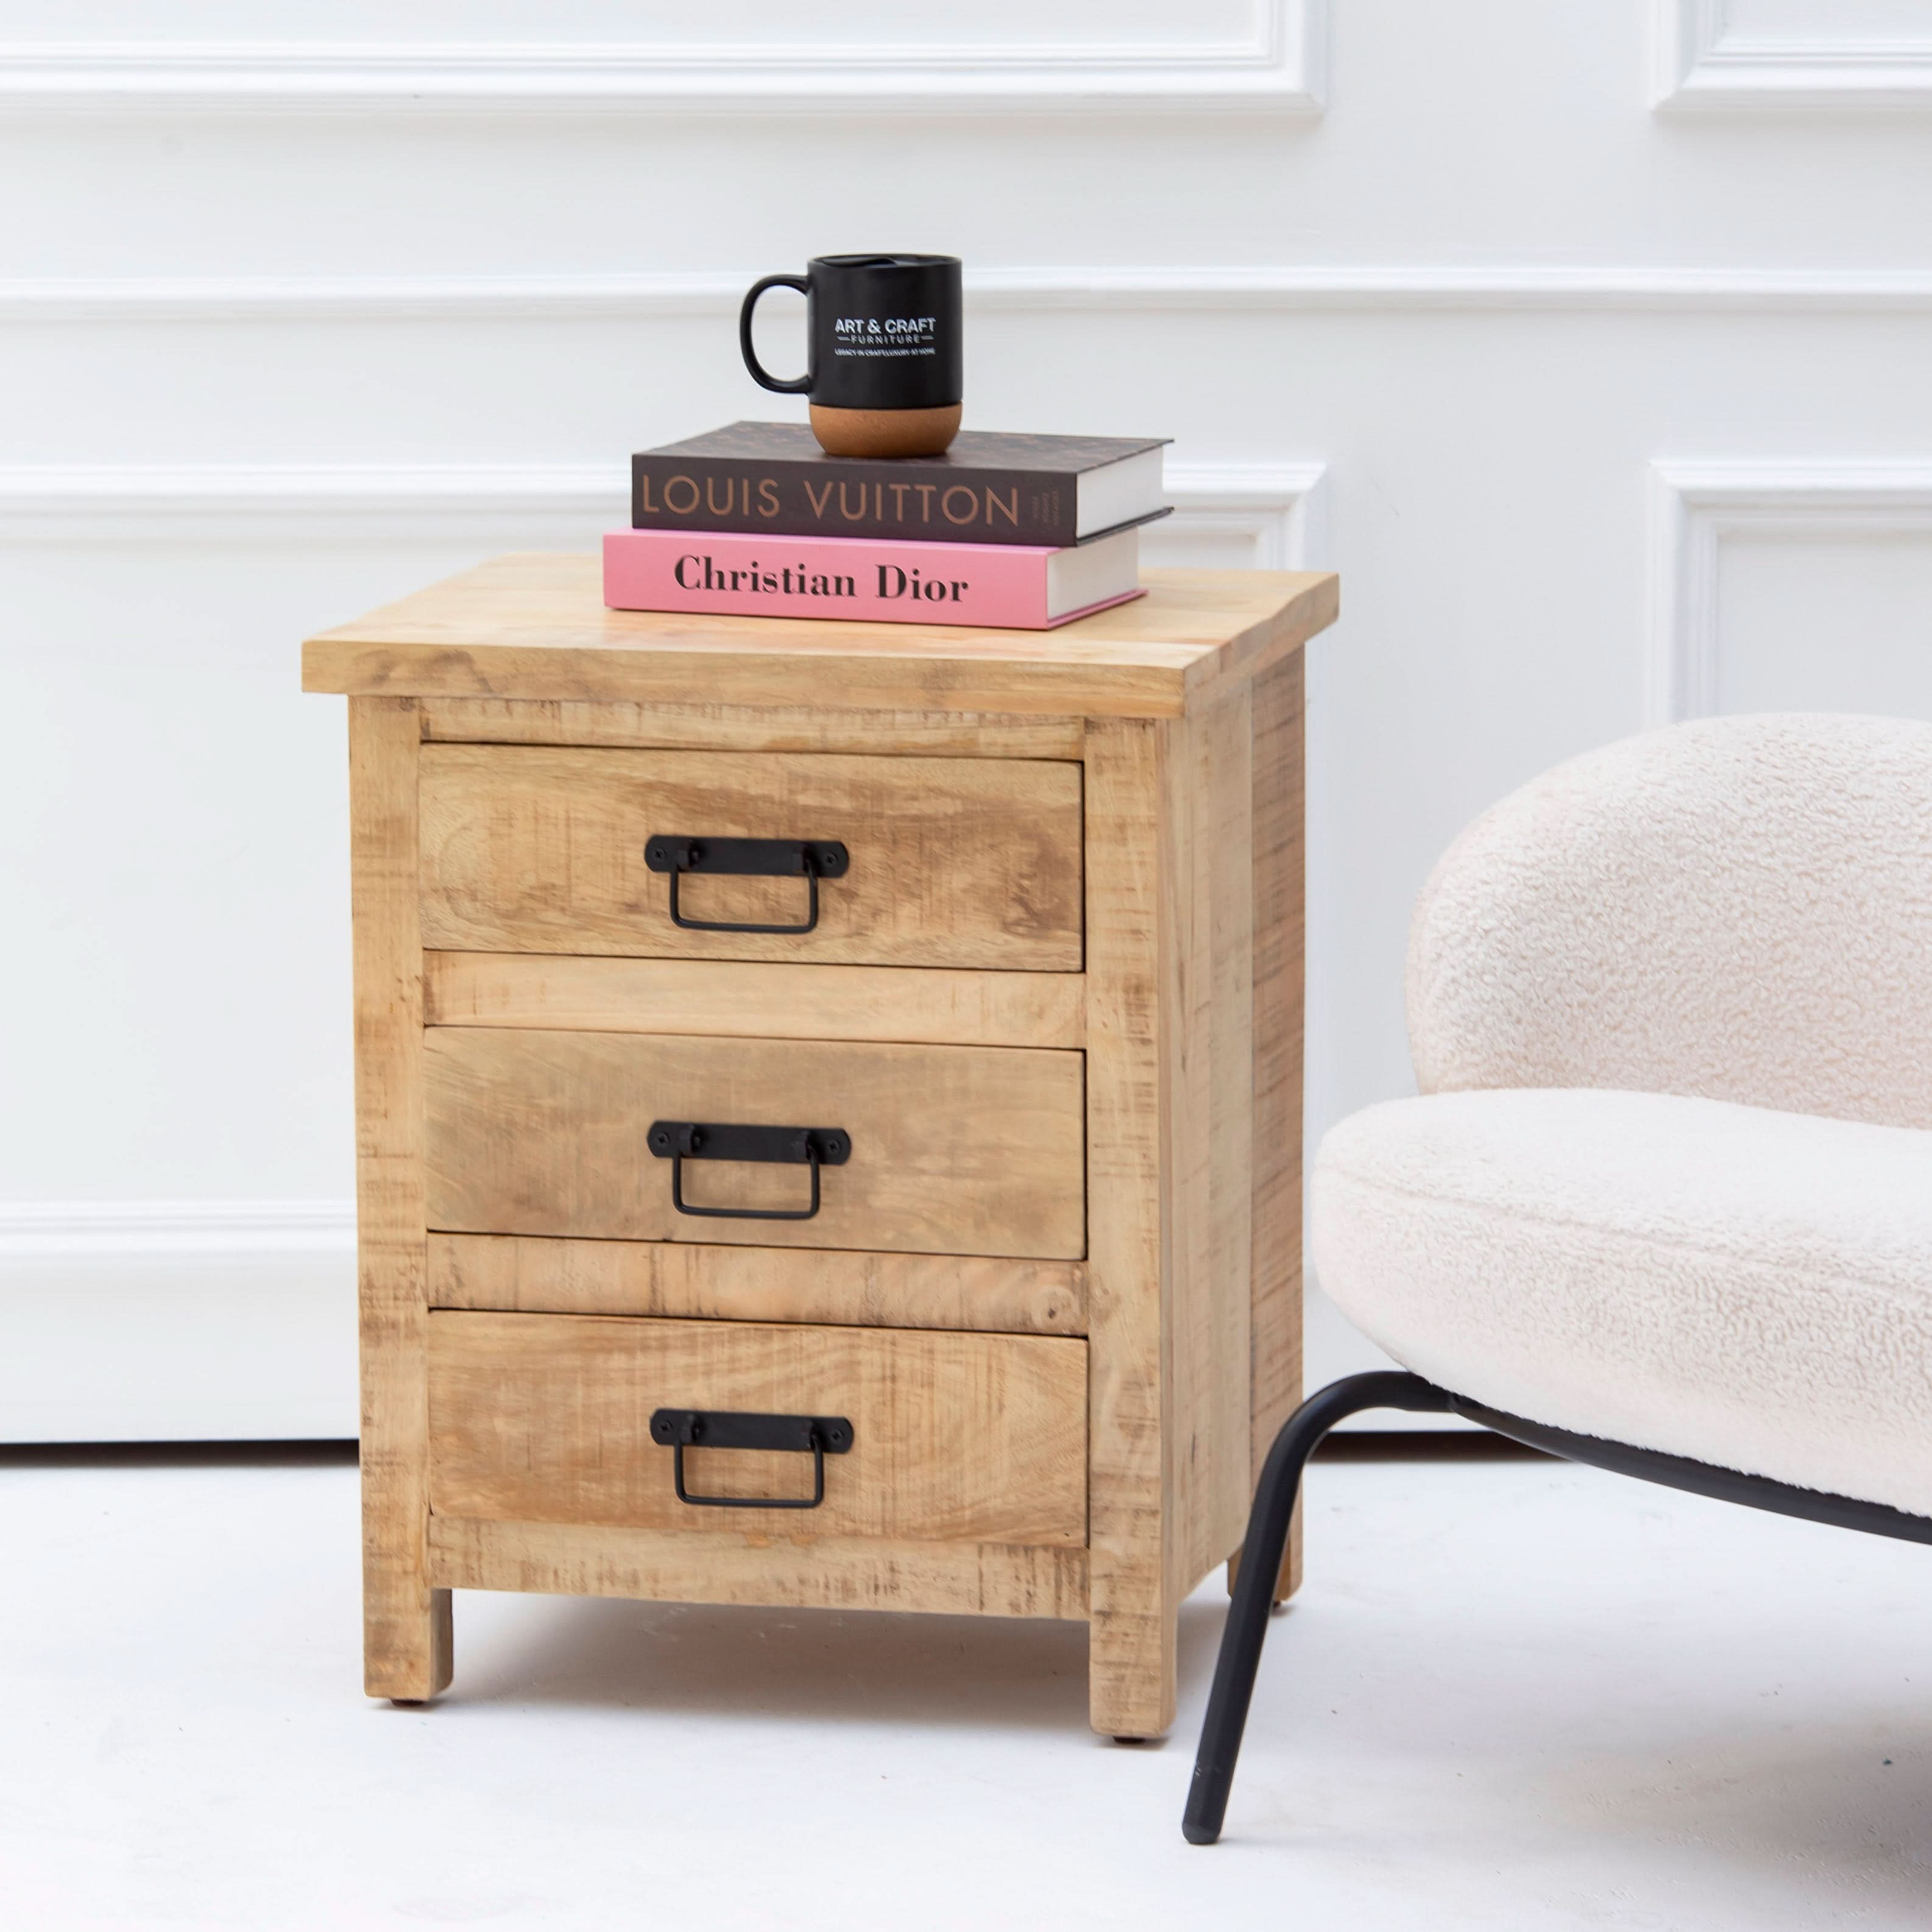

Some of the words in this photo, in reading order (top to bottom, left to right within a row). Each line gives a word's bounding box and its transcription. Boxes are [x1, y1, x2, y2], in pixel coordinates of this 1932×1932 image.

[835, 318, 865, 334] ART
[867, 318, 882, 334] &
[885, 317, 936, 334] CRAFT
[851, 334, 921, 345] FURNITURE
[642, 474, 780, 518] LOUIS
[802, 479, 1019, 528] VUITTON
[674, 554, 858, 598] Christian
[874, 564, 969, 603] Dior
